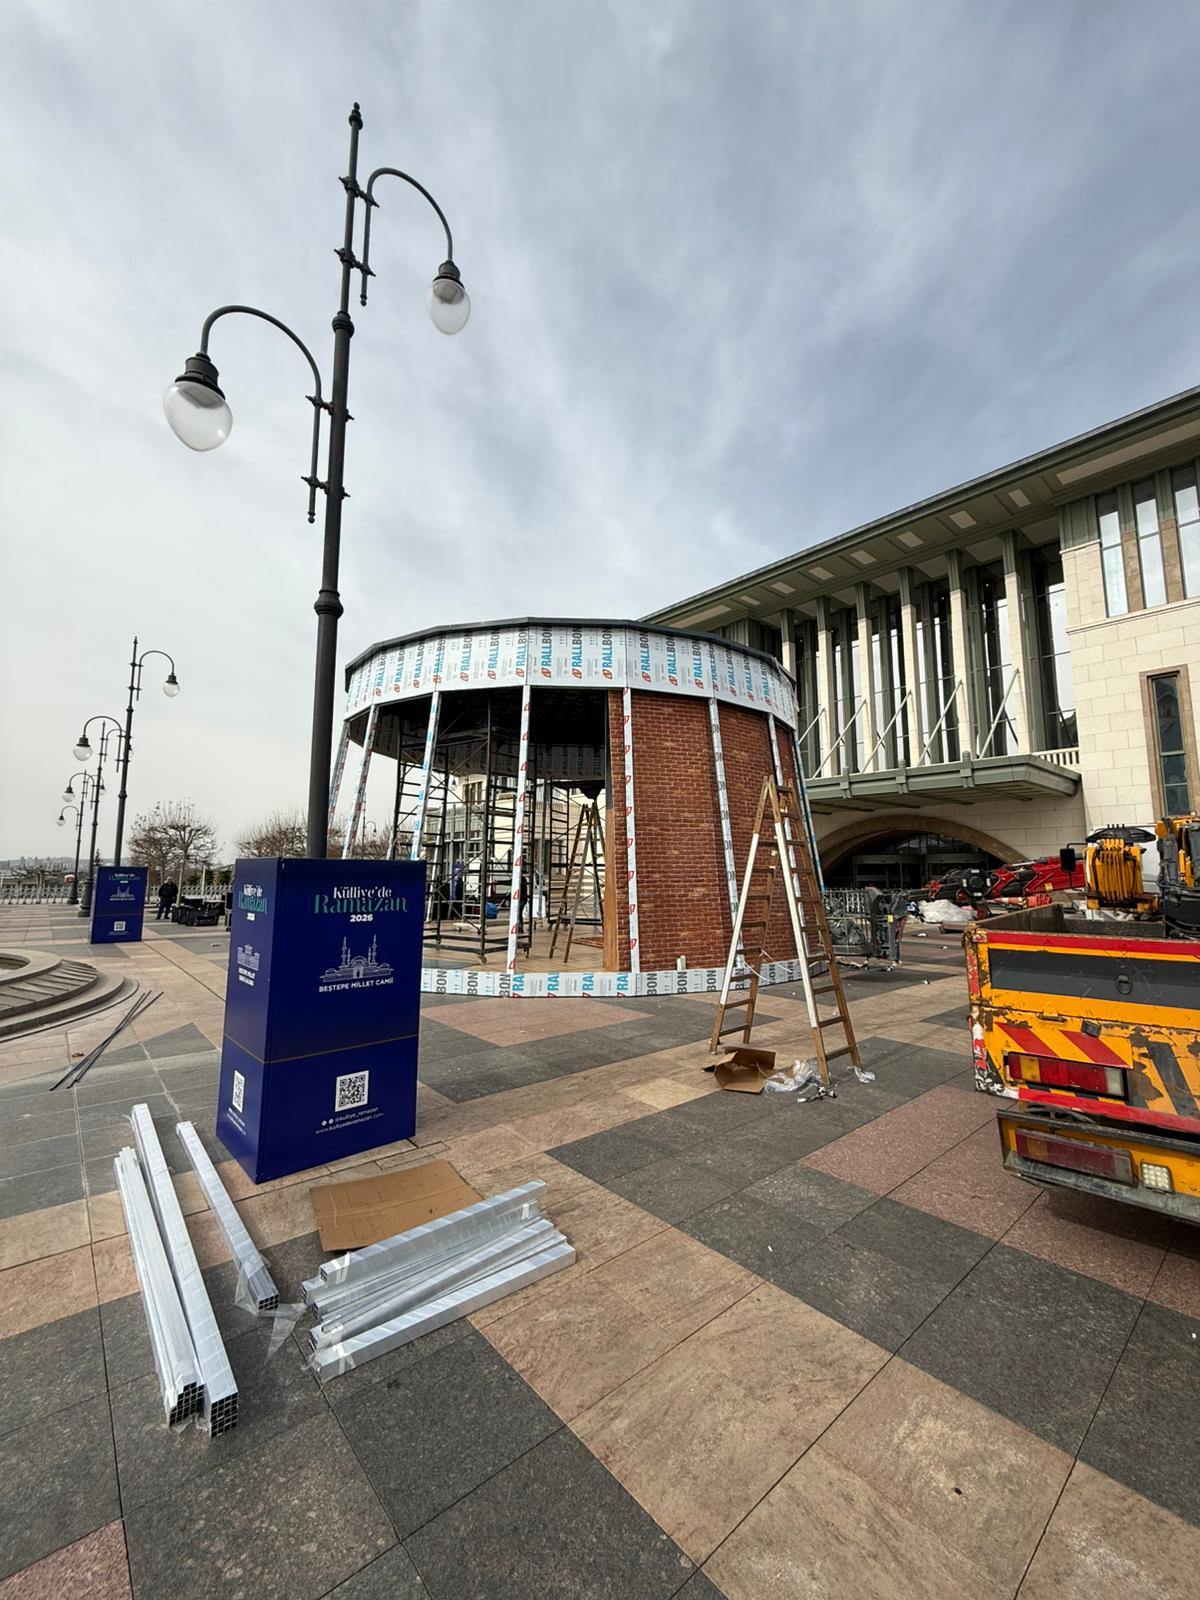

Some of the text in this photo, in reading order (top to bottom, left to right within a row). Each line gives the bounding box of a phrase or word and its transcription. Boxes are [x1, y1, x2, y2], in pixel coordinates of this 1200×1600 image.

[314, 894, 409, 913] Ramazan
[349, 914, 374, 922] 2026
[318, 983, 350, 993] BEŞTEPE
[350, 980, 375, 988] MİLLET
